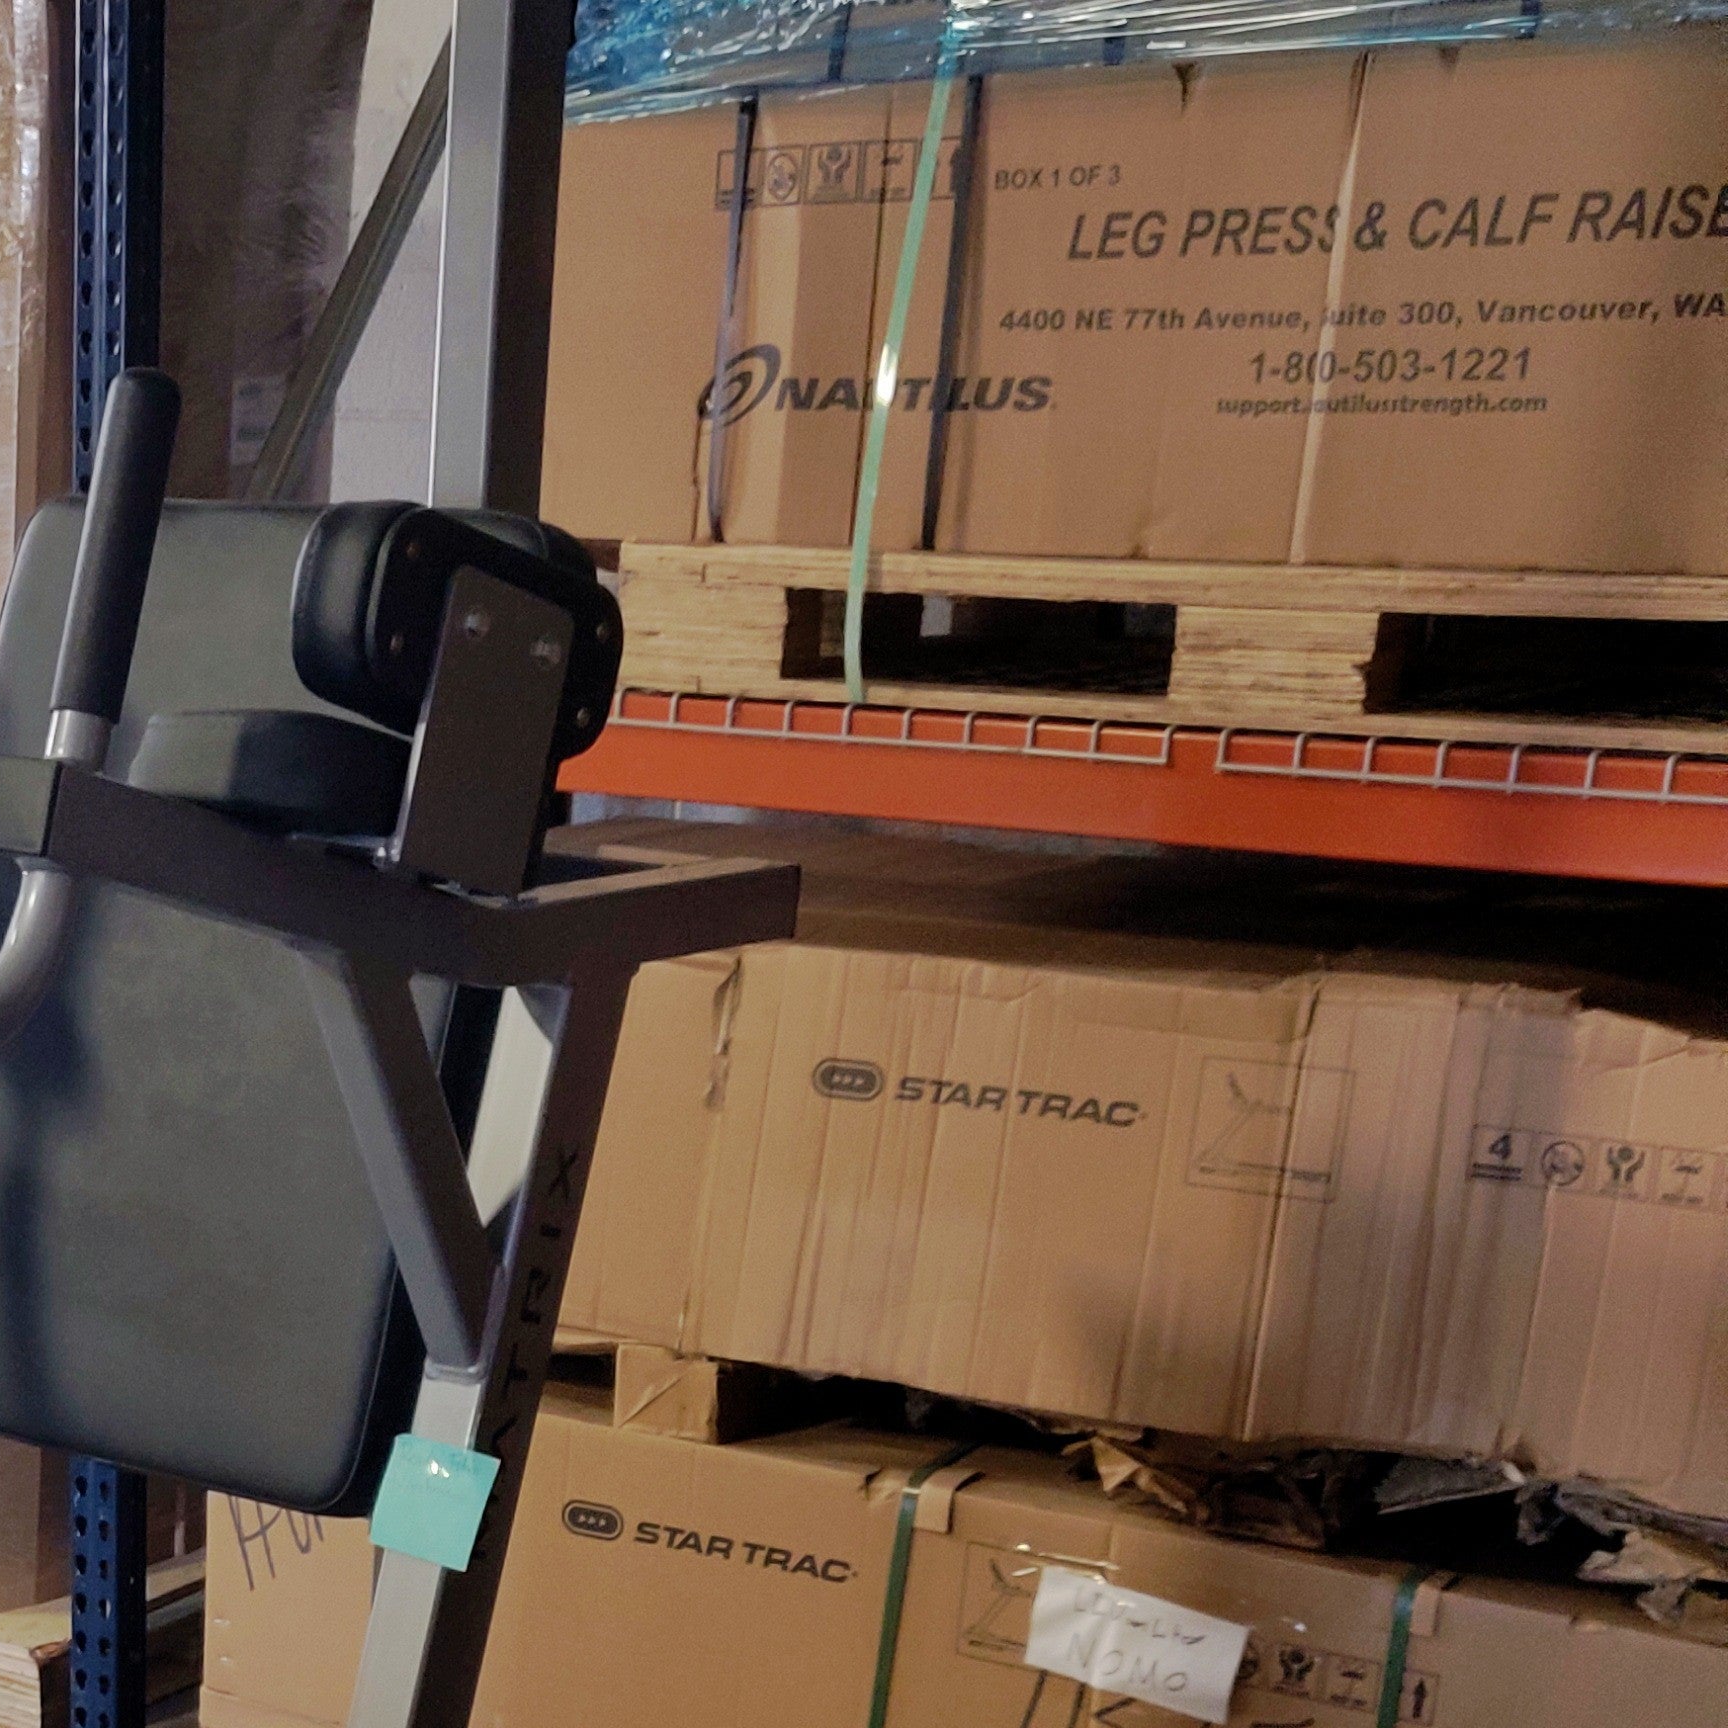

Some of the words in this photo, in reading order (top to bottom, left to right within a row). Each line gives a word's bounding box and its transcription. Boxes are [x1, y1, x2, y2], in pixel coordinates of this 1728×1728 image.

[995, 168, 1042, 190] BOX
[1050, 168, 1060, 187] 1
[1069, 165, 1101, 186] OF
[1109, 164, 1122, 186] 3
[1067, 210, 1168, 260] LEG
[1179, 204, 1342, 258] PRESS
[1352, 201, 1387, 251] &
[1408, 193, 1560, 250] CALF
[1566, 183, 1728, 244] RAISE
[999, 308, 1065, 331] 4400
[1074, 308, 1113, 331] NE
[1125, 306, 1185, 331] 77th
[1193, 306, 1310, 333] Avenue,
[1397, 300, 1463, 329] 300,
[1477, 297, 1660, 325] Vancouver,
[1674, 292, 1728, 318] WA
[1250, 346, 1531, 385] 1-800-503-1221
[774, 375, 1054, 412] NATLUS
[895, 1075, 1008, 1112] STAR
[1015, 1088, 1140, 1129] TRAC
[1489, 1133, 1513, 1161] 4
[633, 1520, 735, 1561] STAR
[742, 1541, 852, 1584] TRAC
